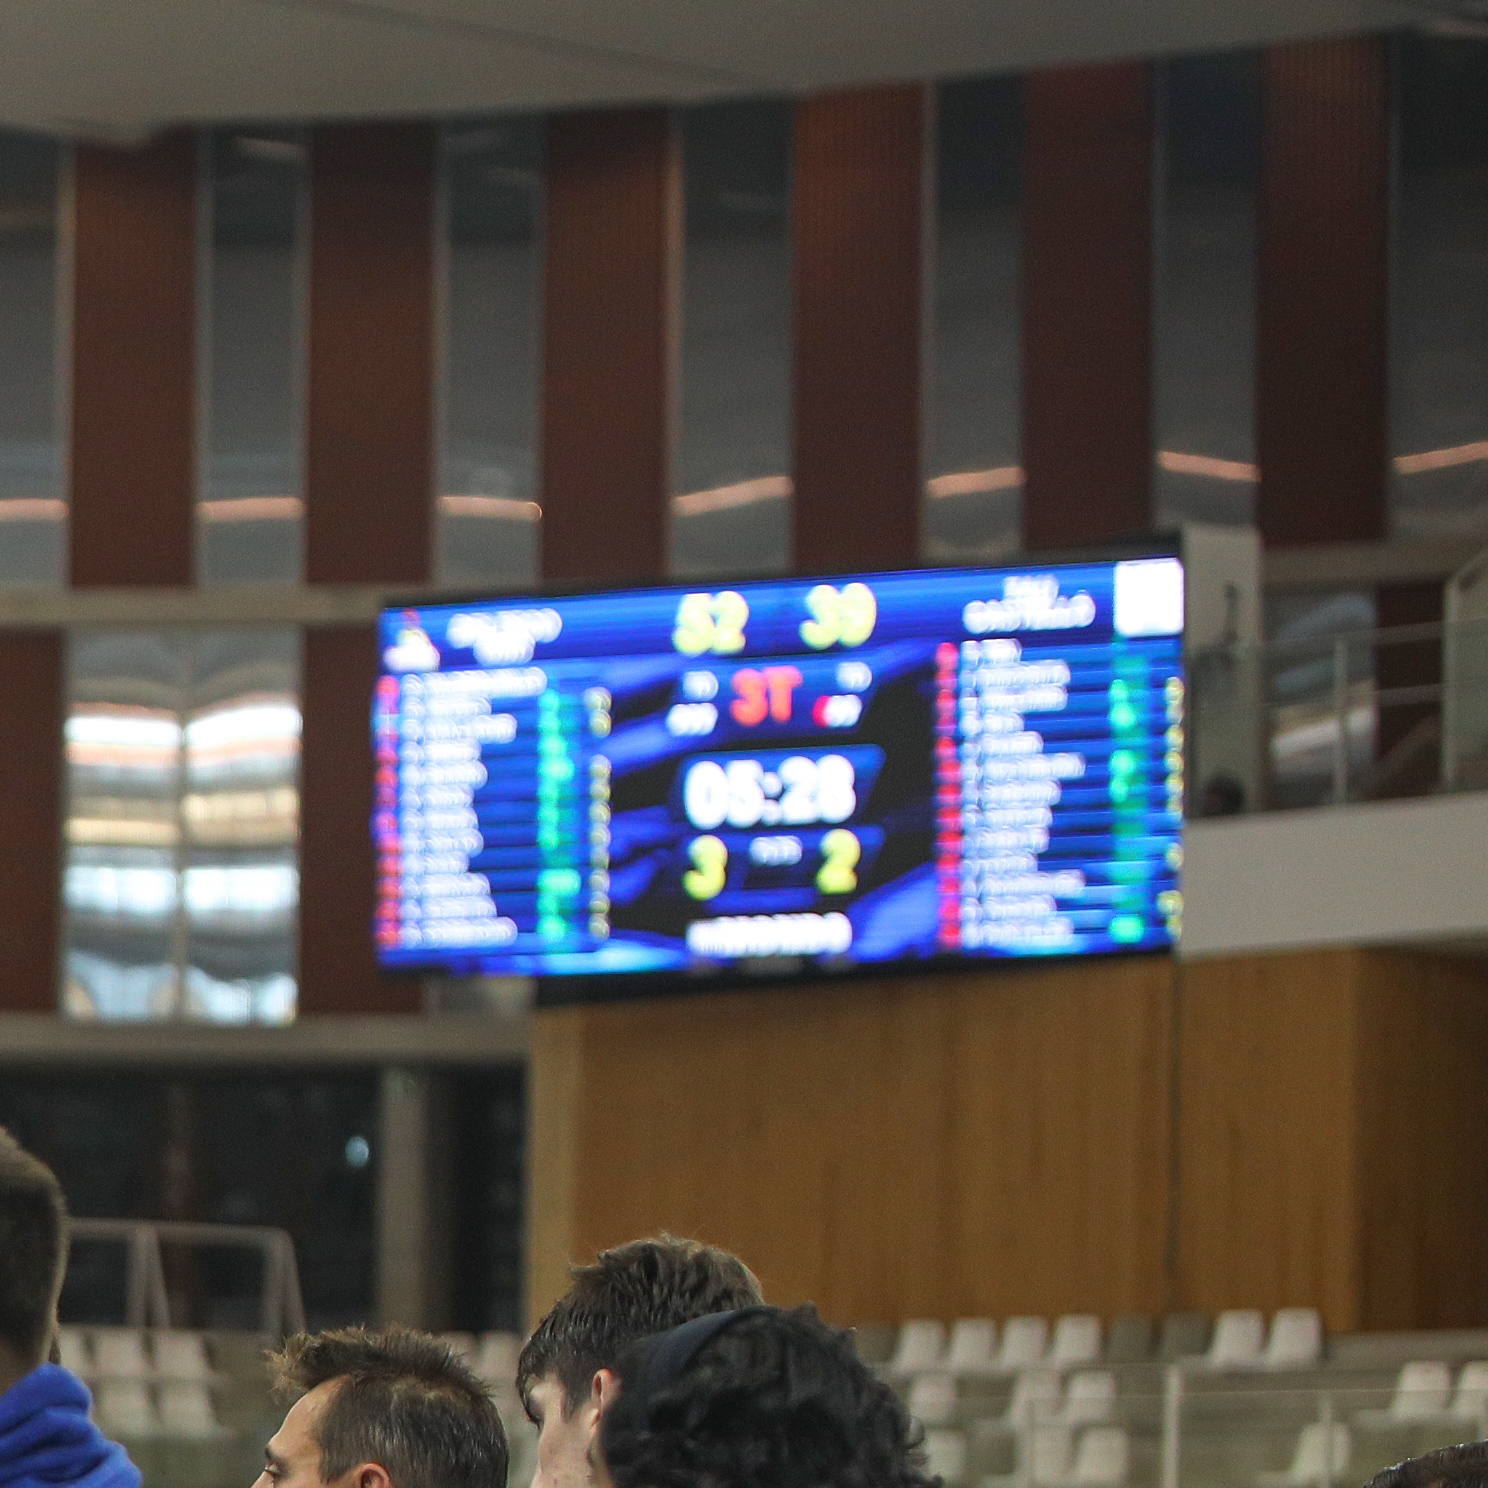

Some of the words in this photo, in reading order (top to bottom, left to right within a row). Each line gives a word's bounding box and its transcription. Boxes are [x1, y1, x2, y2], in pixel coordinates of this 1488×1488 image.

[684, 754, 857, 830] 05:28
[681, 834, 728, 901] 3
[816, 828, 861, 896] 2
